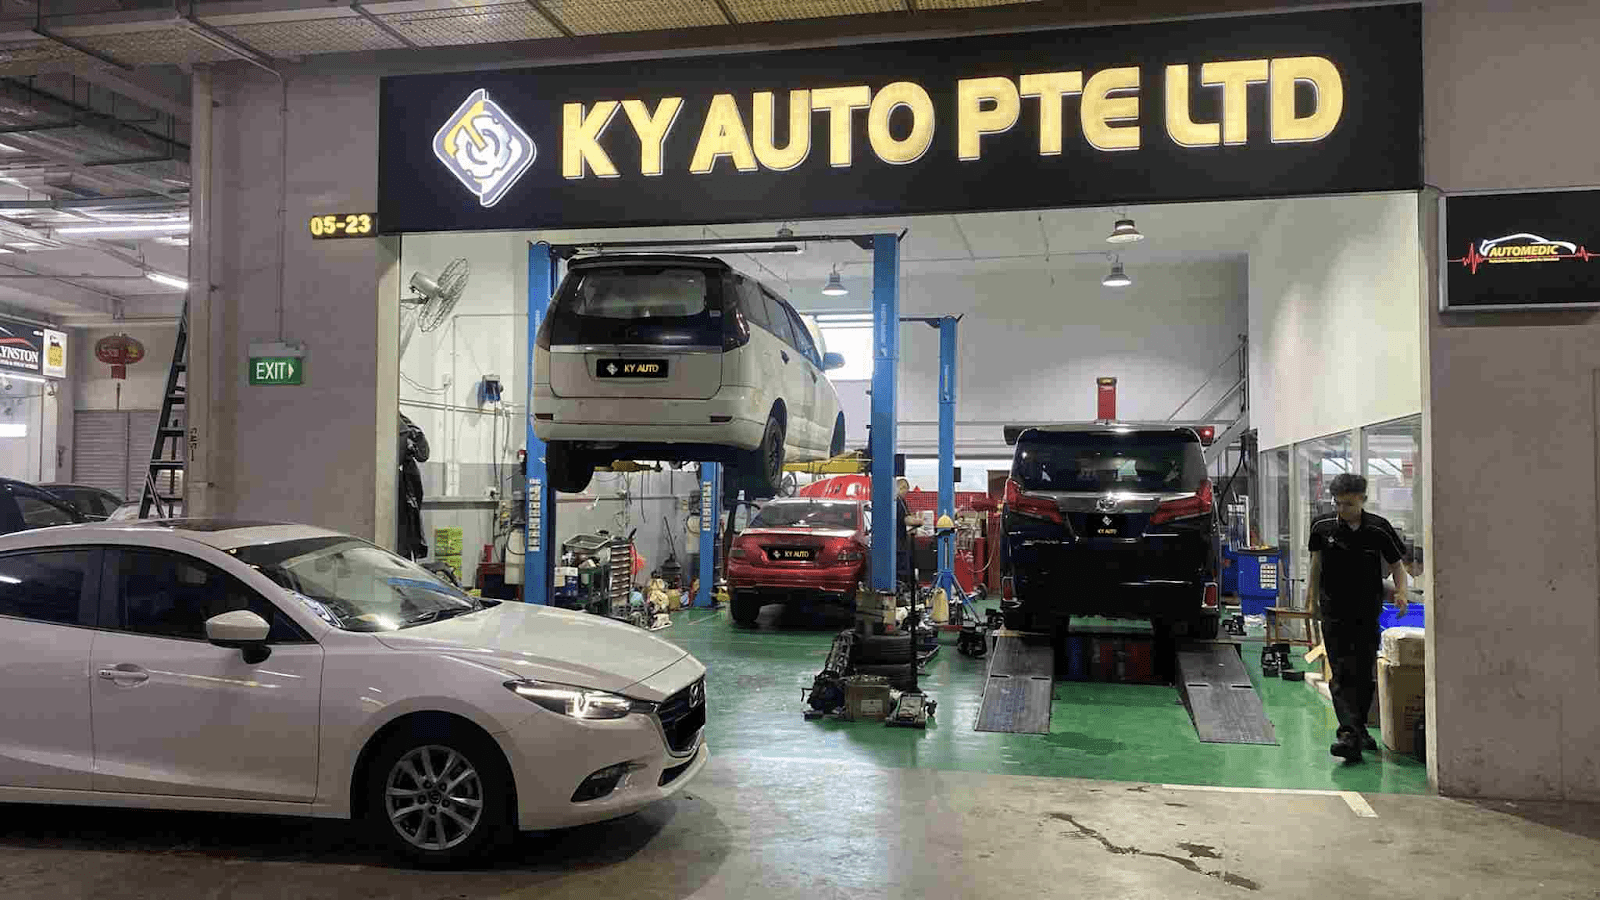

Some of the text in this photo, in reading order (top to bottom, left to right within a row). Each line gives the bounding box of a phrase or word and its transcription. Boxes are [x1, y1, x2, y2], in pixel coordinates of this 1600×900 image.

[562, 56, 1344, 179] KY AUTO PTE LTD
[310, 214, 371, 235] 05-23
[1489, 246, 1559, 257] AUTOMEDIC
[256, 362, 287, 379] EXIT
[624, 364, 659, 373] KY AUTO
